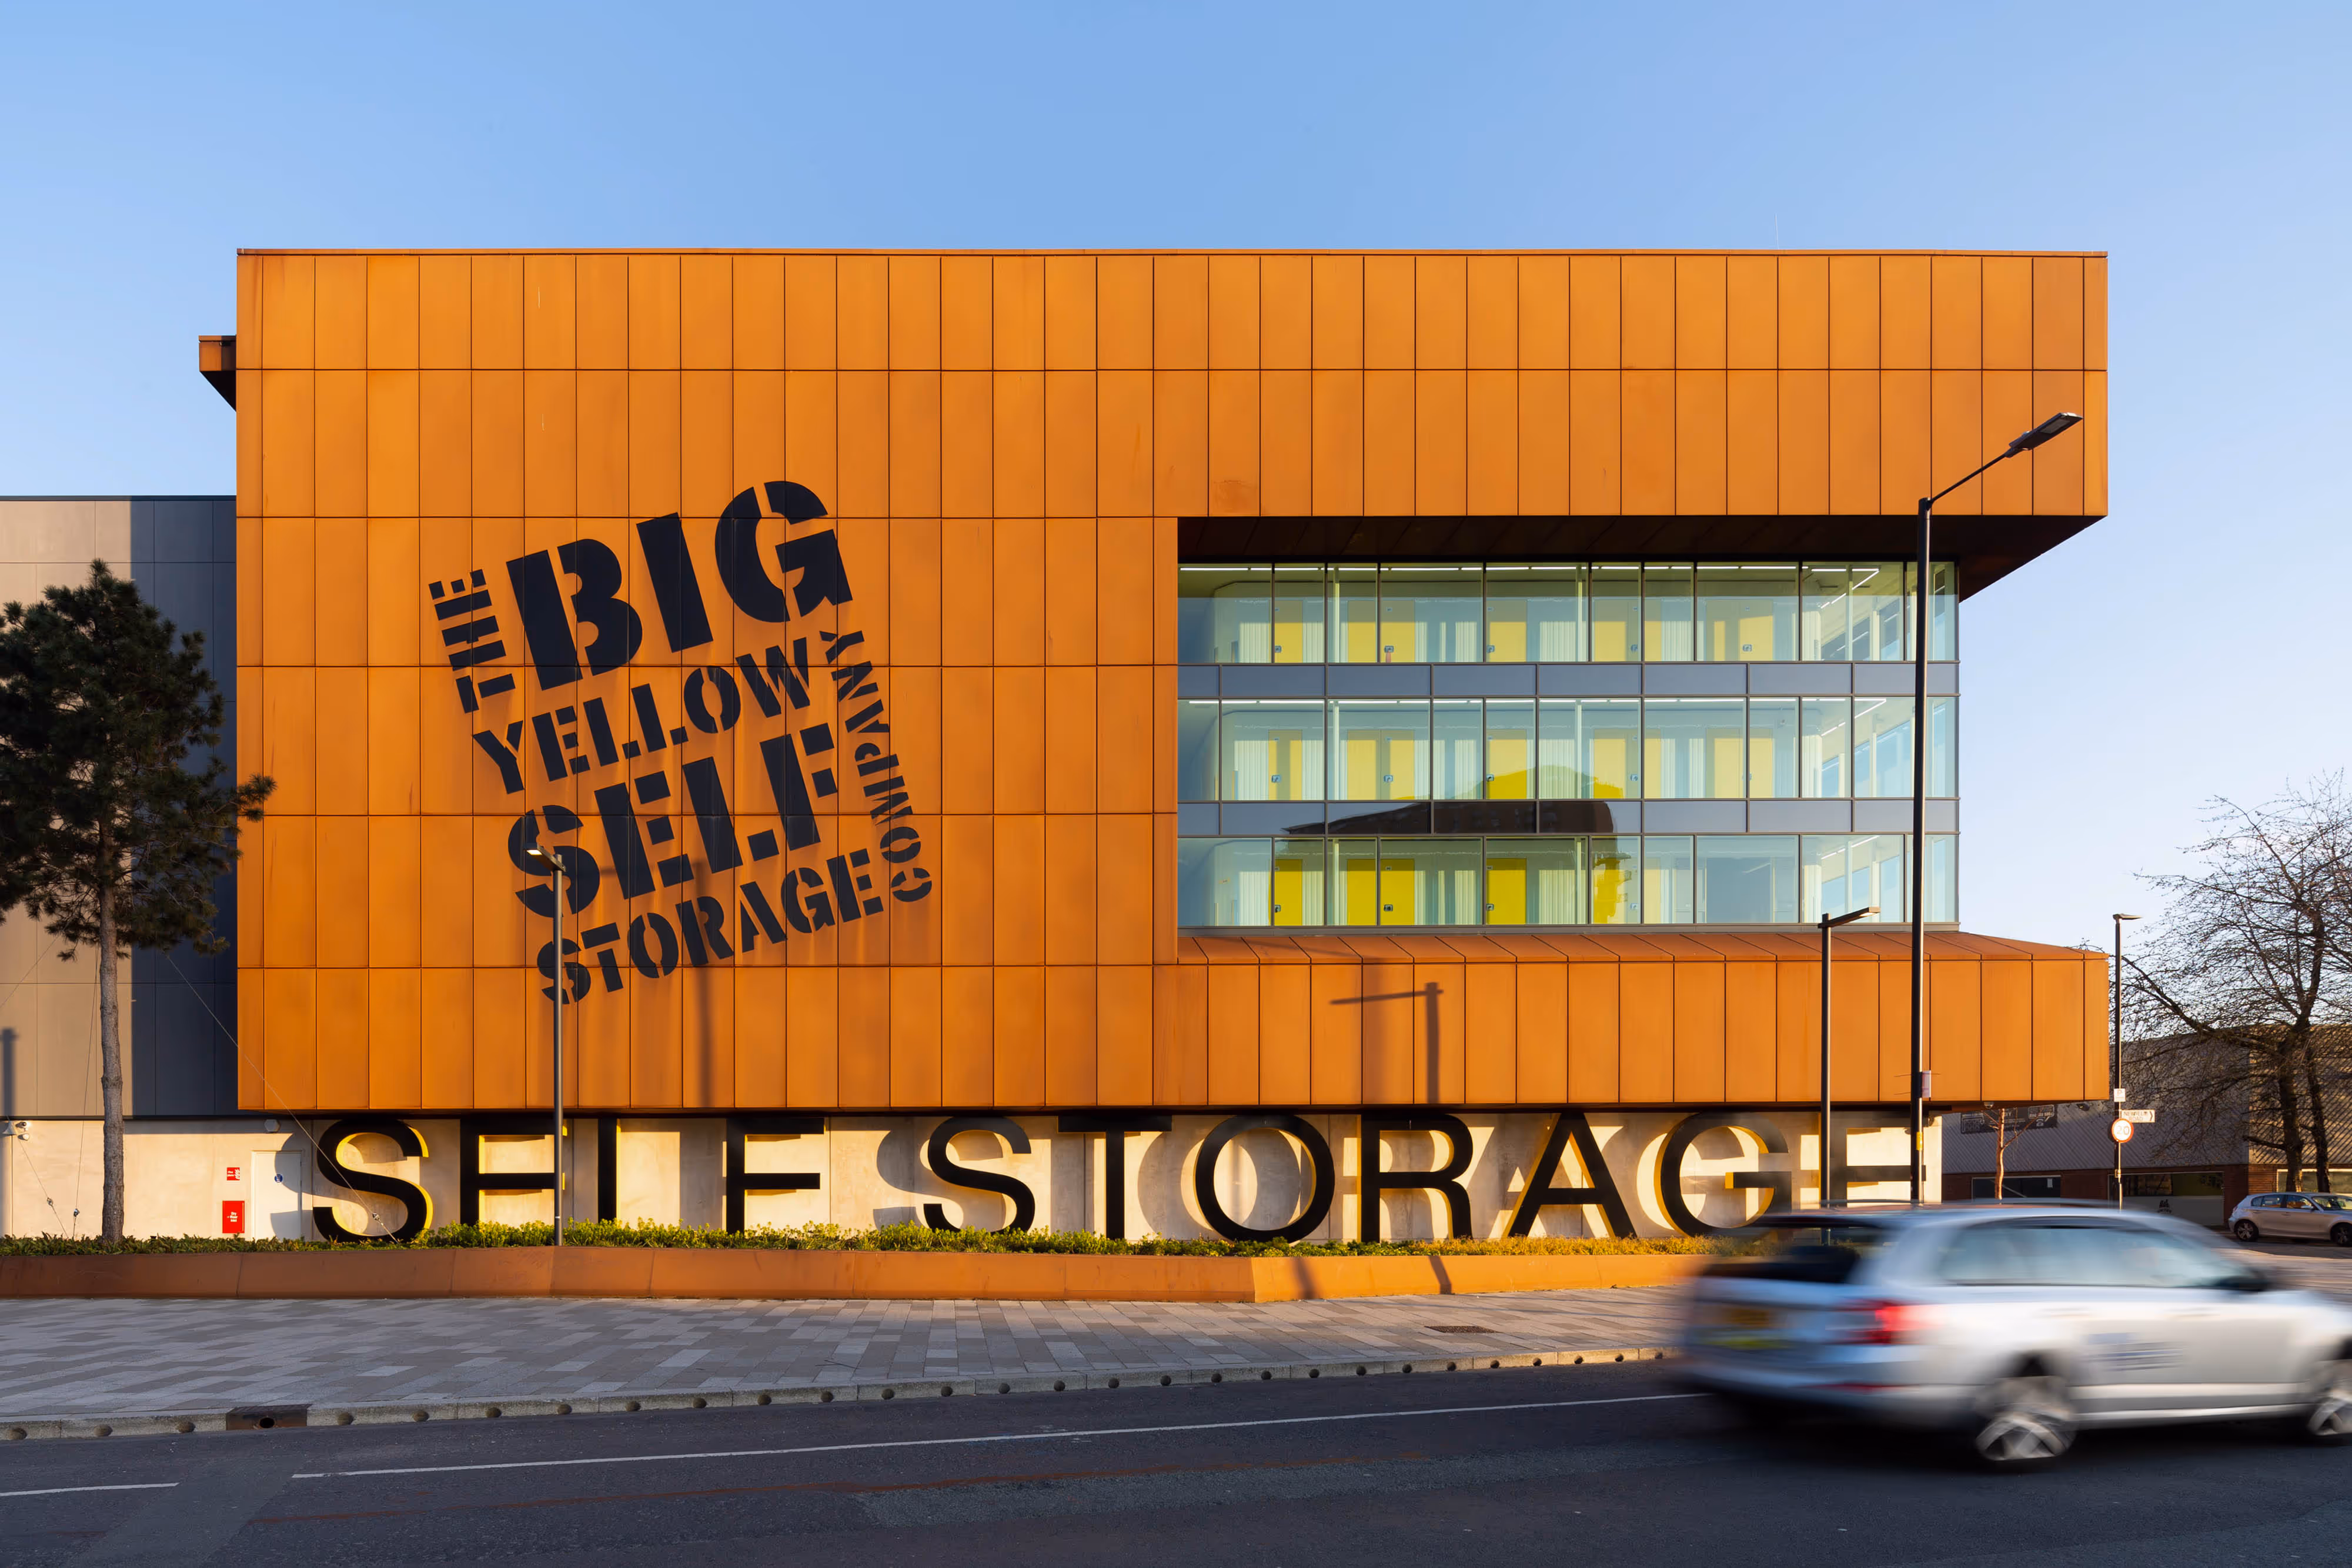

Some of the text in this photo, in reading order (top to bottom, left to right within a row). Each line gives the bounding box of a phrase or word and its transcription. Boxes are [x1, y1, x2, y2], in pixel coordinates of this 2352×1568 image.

[428, 569, 516, 714] THE
[506, 480, 853, 690] BIG
[472, 637, 810, 794] YELLOW
[819, 630, 933, 902] COMPANY
[507, 723, 838, 918] SELF
[536, 848, 884, 1004] STORAGE
[2117, 1125, 2130, 1135] 20
